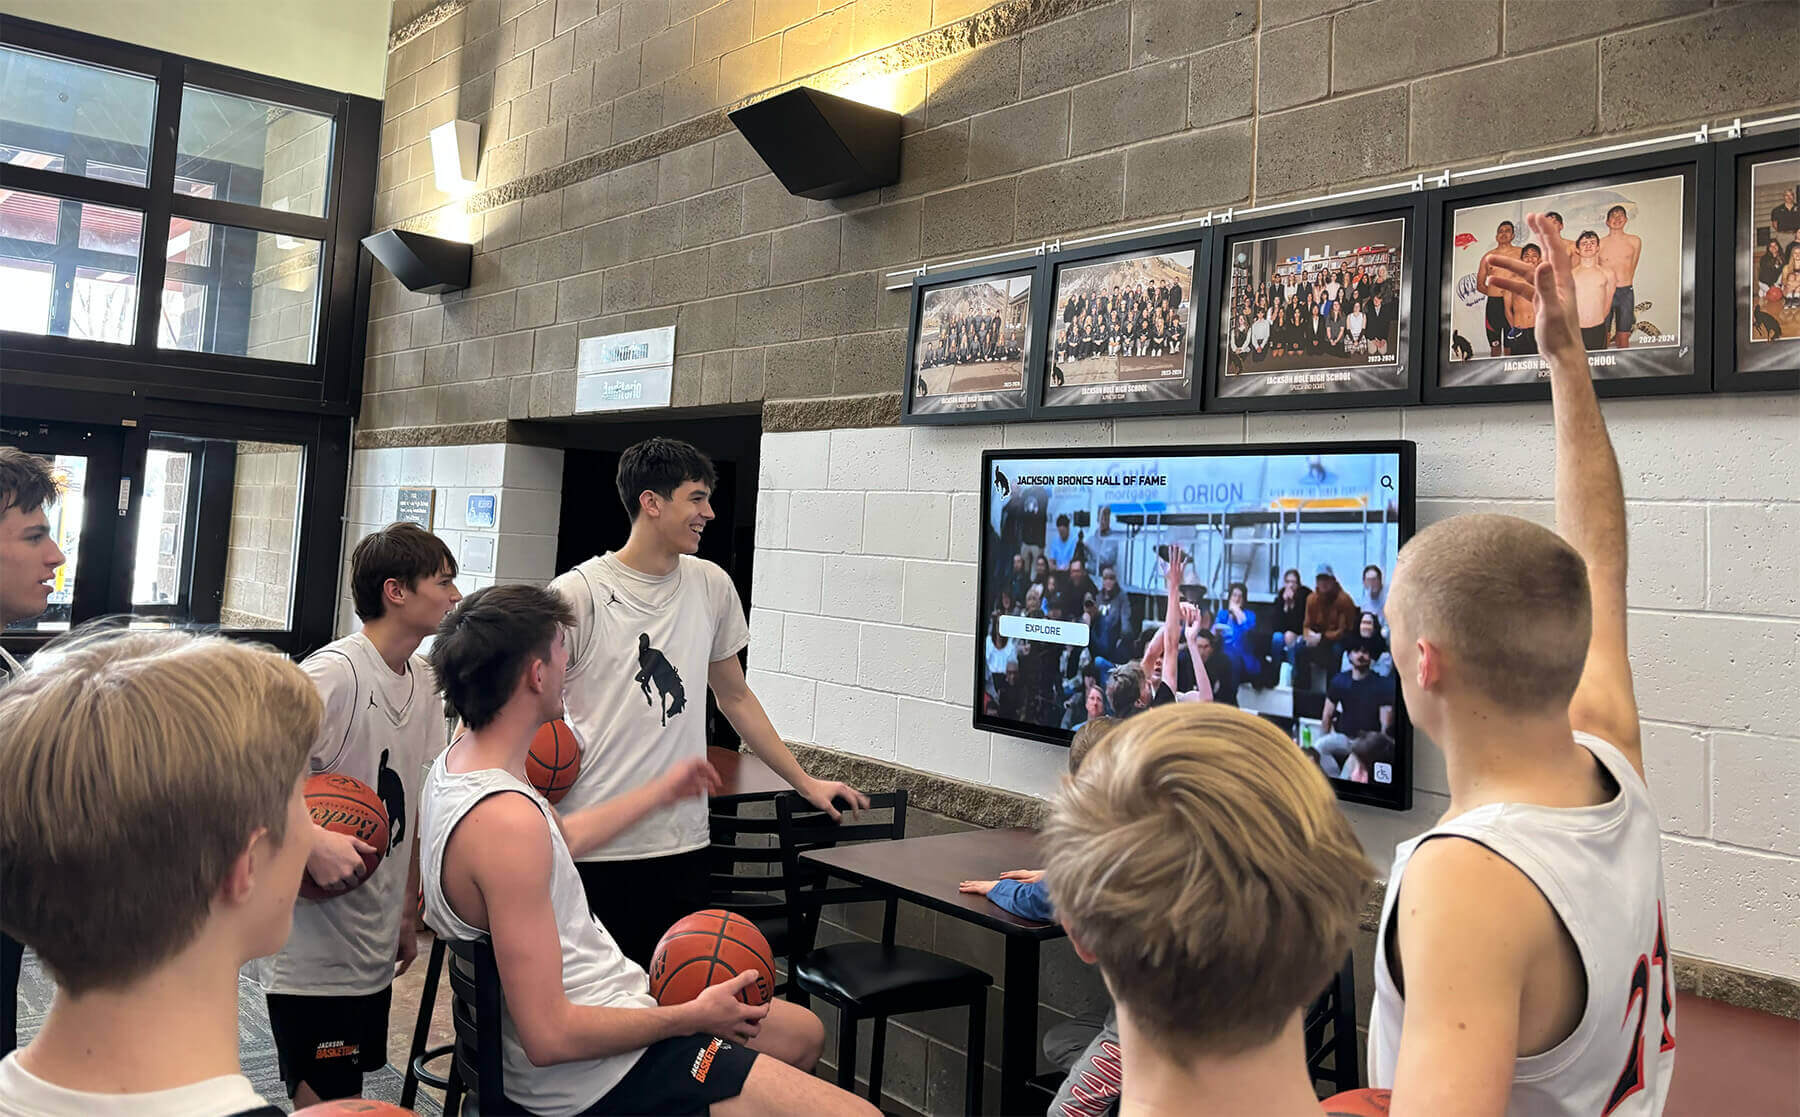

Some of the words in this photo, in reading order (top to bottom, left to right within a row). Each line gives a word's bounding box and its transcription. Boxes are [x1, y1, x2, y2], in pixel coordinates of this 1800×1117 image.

[1639, 334, 1675, 344] 2023-2024
[1504, 360, 1538, 371] JACKSON
[1588, 355, 1616, 366] CHOOL
[1266, 375, 1293, 385] JACKSON
[1326, 372, 1351, 382] SCHOOL
[1016, 476, 1055, 486] JACKSON
[1058, 476, 1094, 486] BRONCS
[1096, 475, 1121, 486] HALL
[1123, 475, 1137, 486] OF
[1138, 475, 1167, 486] FAME
[1184, 482, 1244, 504] ORION
[1025, 623, 1061, 636] EXPLORE
[316, 1040, 344, 1049] JACKSON
